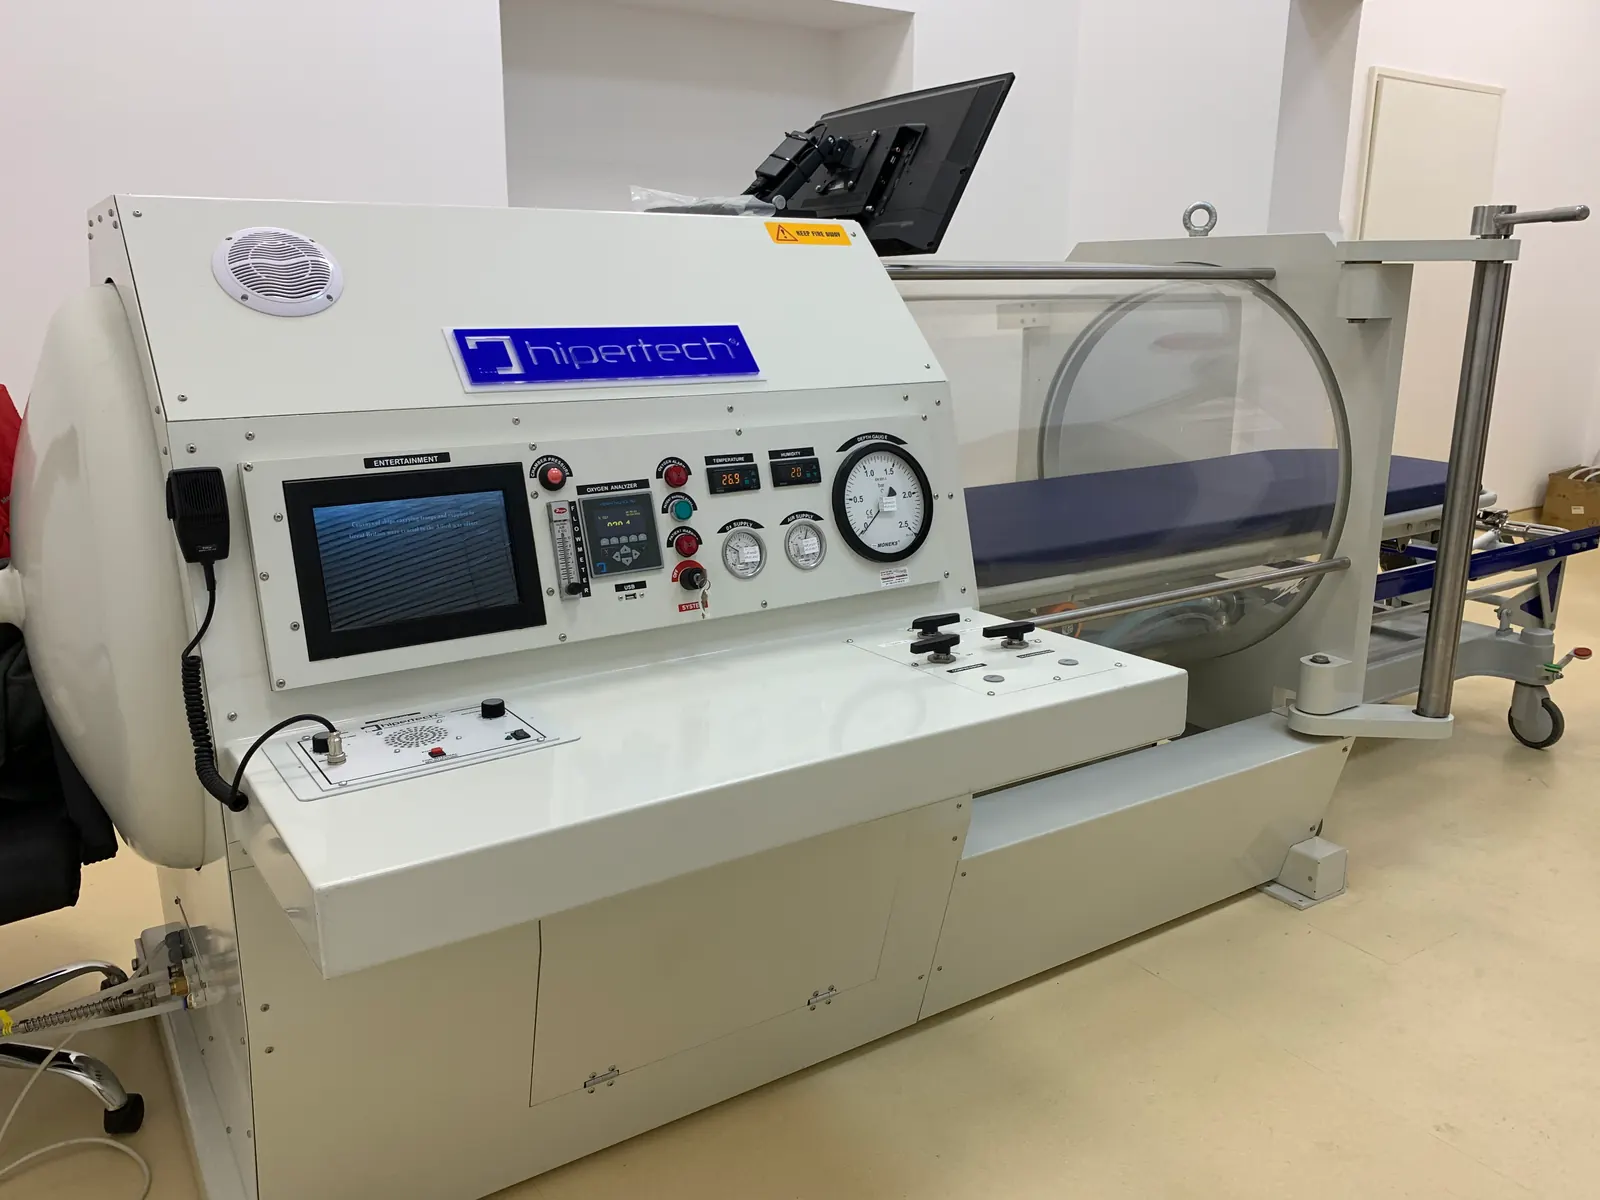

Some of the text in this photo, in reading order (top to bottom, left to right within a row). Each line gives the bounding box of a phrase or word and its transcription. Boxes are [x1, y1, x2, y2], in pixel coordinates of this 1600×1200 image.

[524, 337, 736, 370] hipertech
[373, 455, 438, 467] ENTERTAINMENT
[658, 460, 671, 472] OXYGEN
[530, 457, 570, 477] CHAMBER PRESSURE
[791, 467, 802, 478] 20
[722, 472, 740, 486] 26.9
[864, 470, 874, 478] 1.0
[610, 482, 638, 490] ANALYZER
[853, 496, 864, 504] 0.5
[788, 514, 796, 522] AIR
[898, 520, 908, 528] 2.5
[570, 506, 589, 594] FLOWMETER
[681, 602, 700, 610] SYSTE
